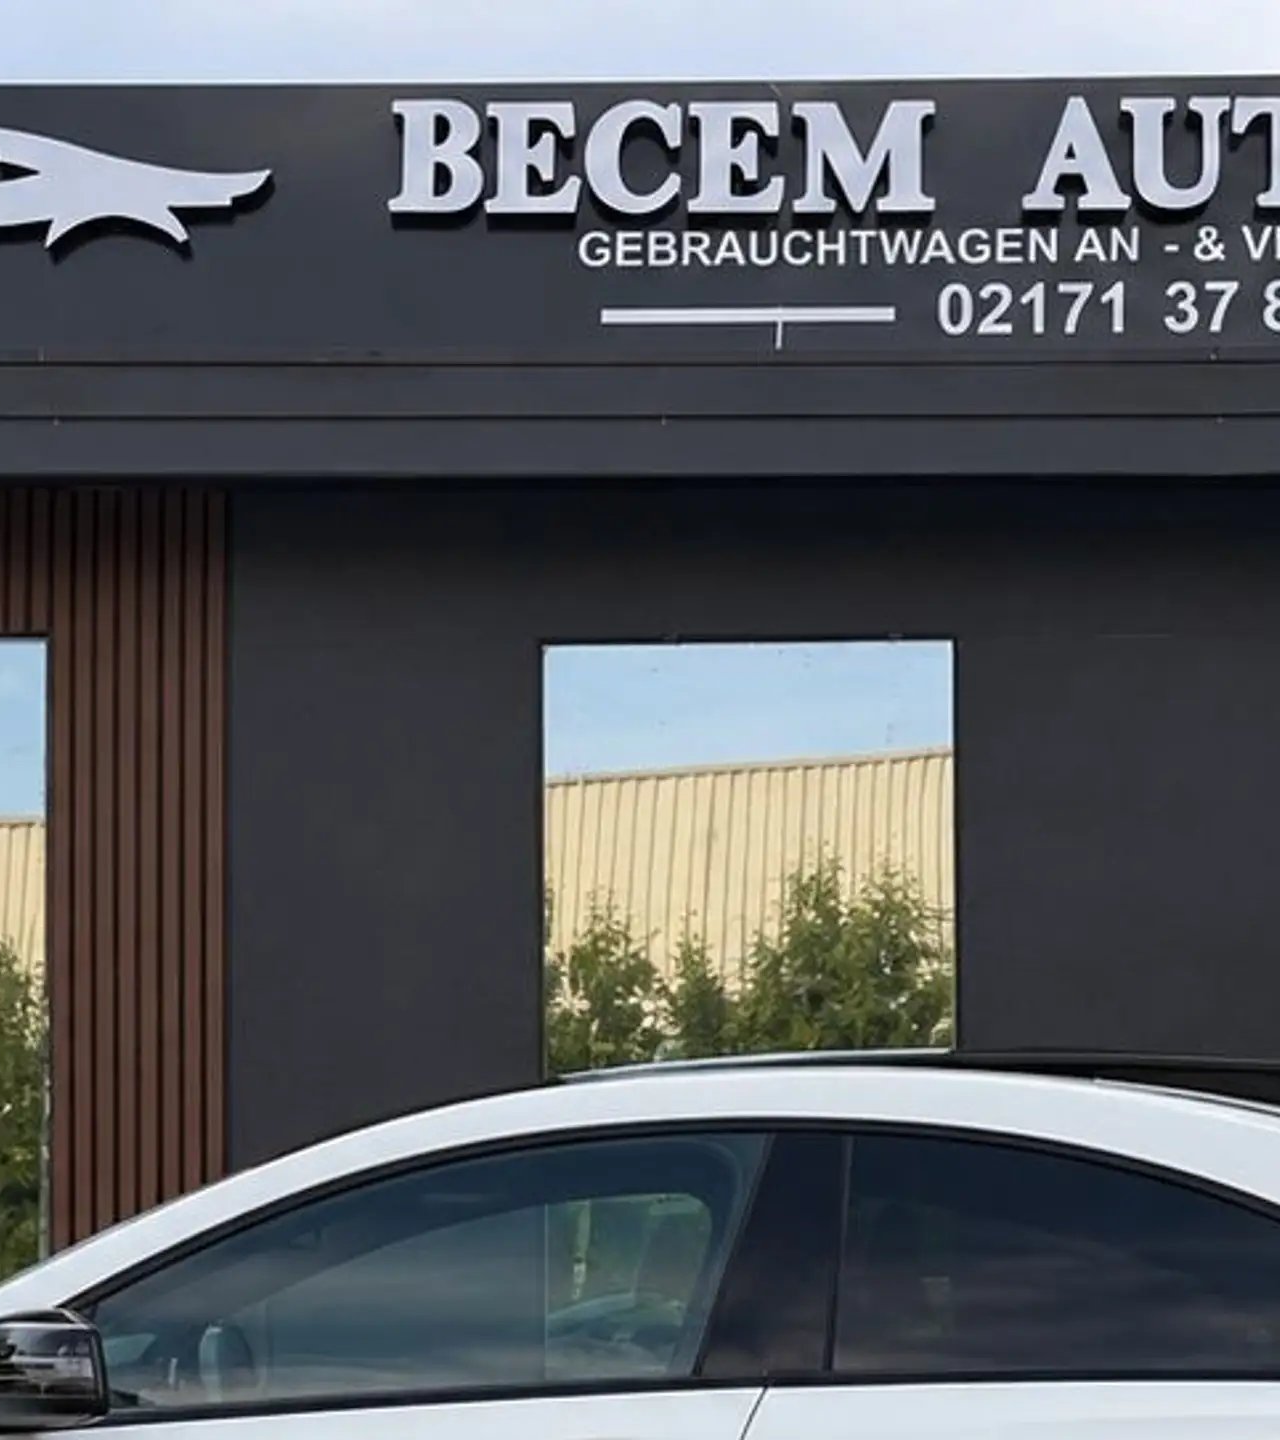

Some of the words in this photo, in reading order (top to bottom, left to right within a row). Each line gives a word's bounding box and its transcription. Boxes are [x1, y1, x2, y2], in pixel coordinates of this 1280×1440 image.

[388, 99, 937, 214] BECEM
[578, 228, 1059, 267] GEBRAUCHTWAGEN
[1074, 226, 1140, 262] AN
[1193, 225, 1226, 262] &
[937, 281, 1125, 335] 02171
[1163, 280, 1239, 334] 37
